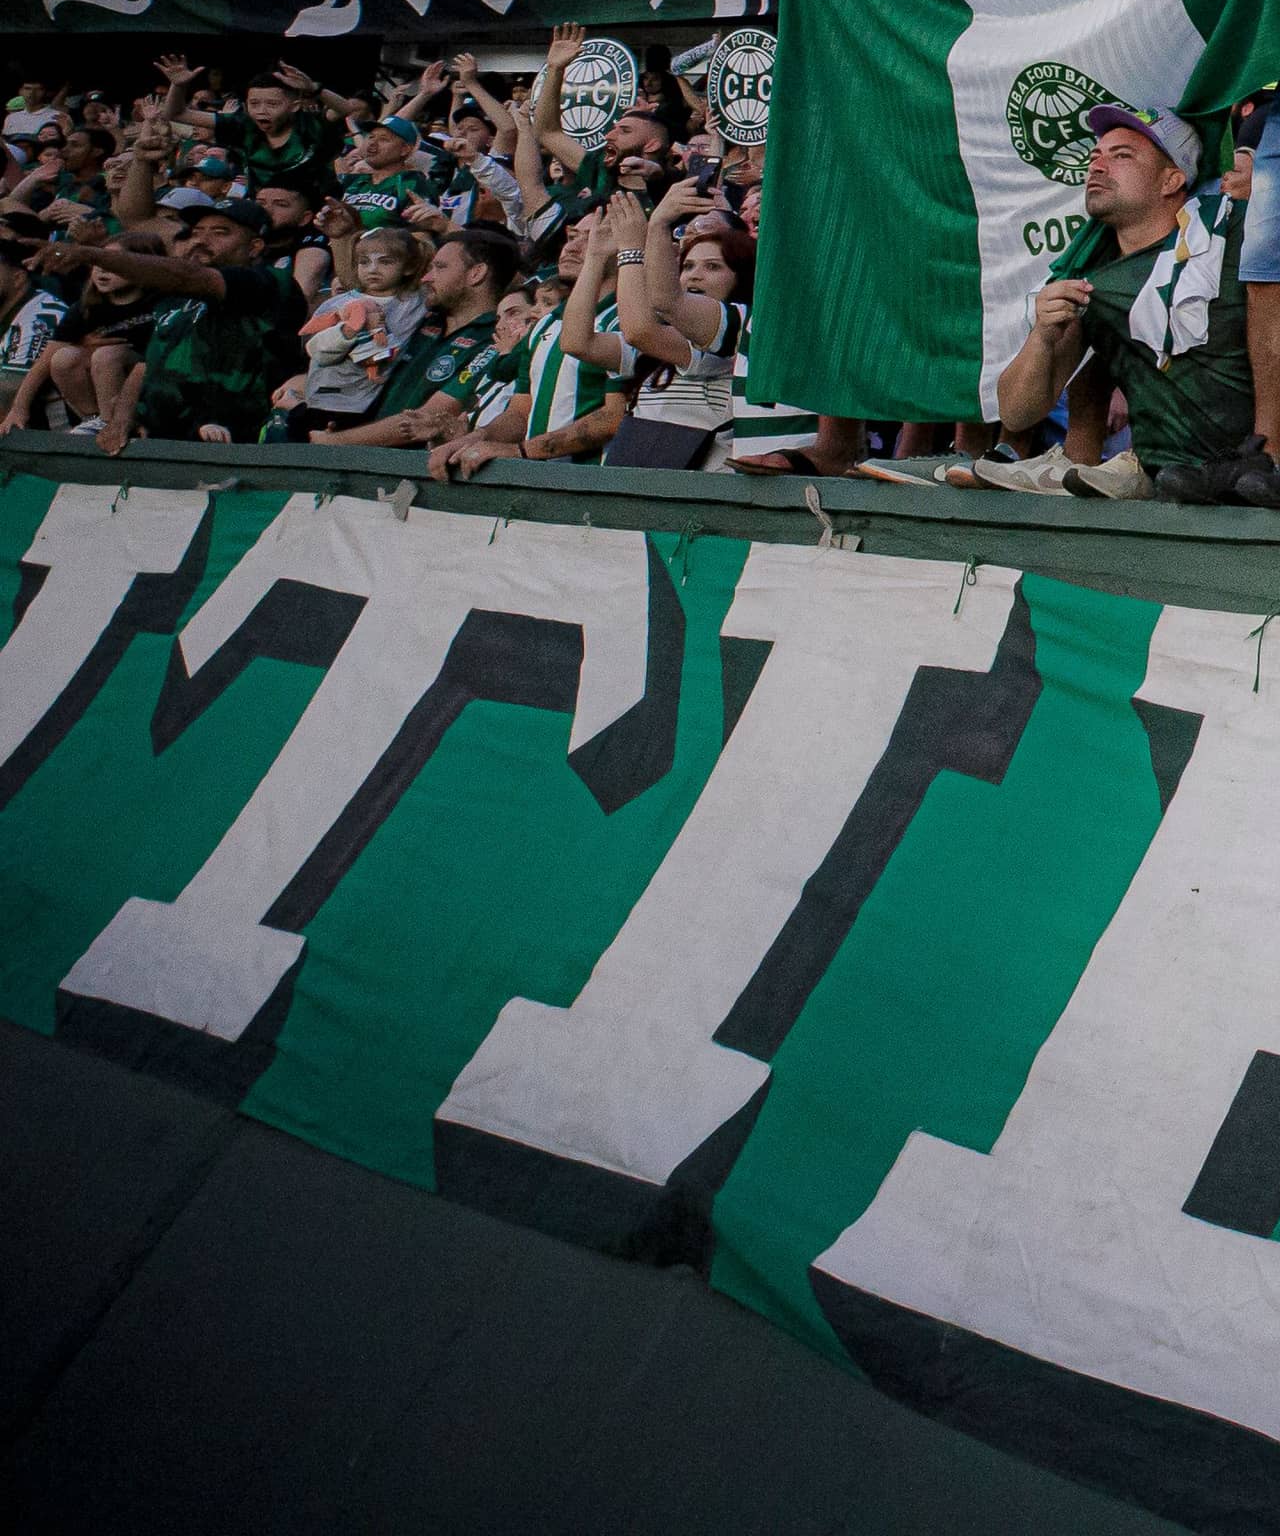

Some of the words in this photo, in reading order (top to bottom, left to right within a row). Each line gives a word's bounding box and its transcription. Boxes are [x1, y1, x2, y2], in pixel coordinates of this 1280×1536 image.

[731, 32, 760, 51] FOOT
[603, 41, 626, 70] BALL
[619, 71, 634, 109] CLUB
[723, 72, 773, 102] CFC
[1007, 80, 1035, 163] CORITIBA
[1026, 64, 1062, 85] FOOT
[1064, 68, 1106, 102] BALL
[1032, 109, 1095, 150] CFC
